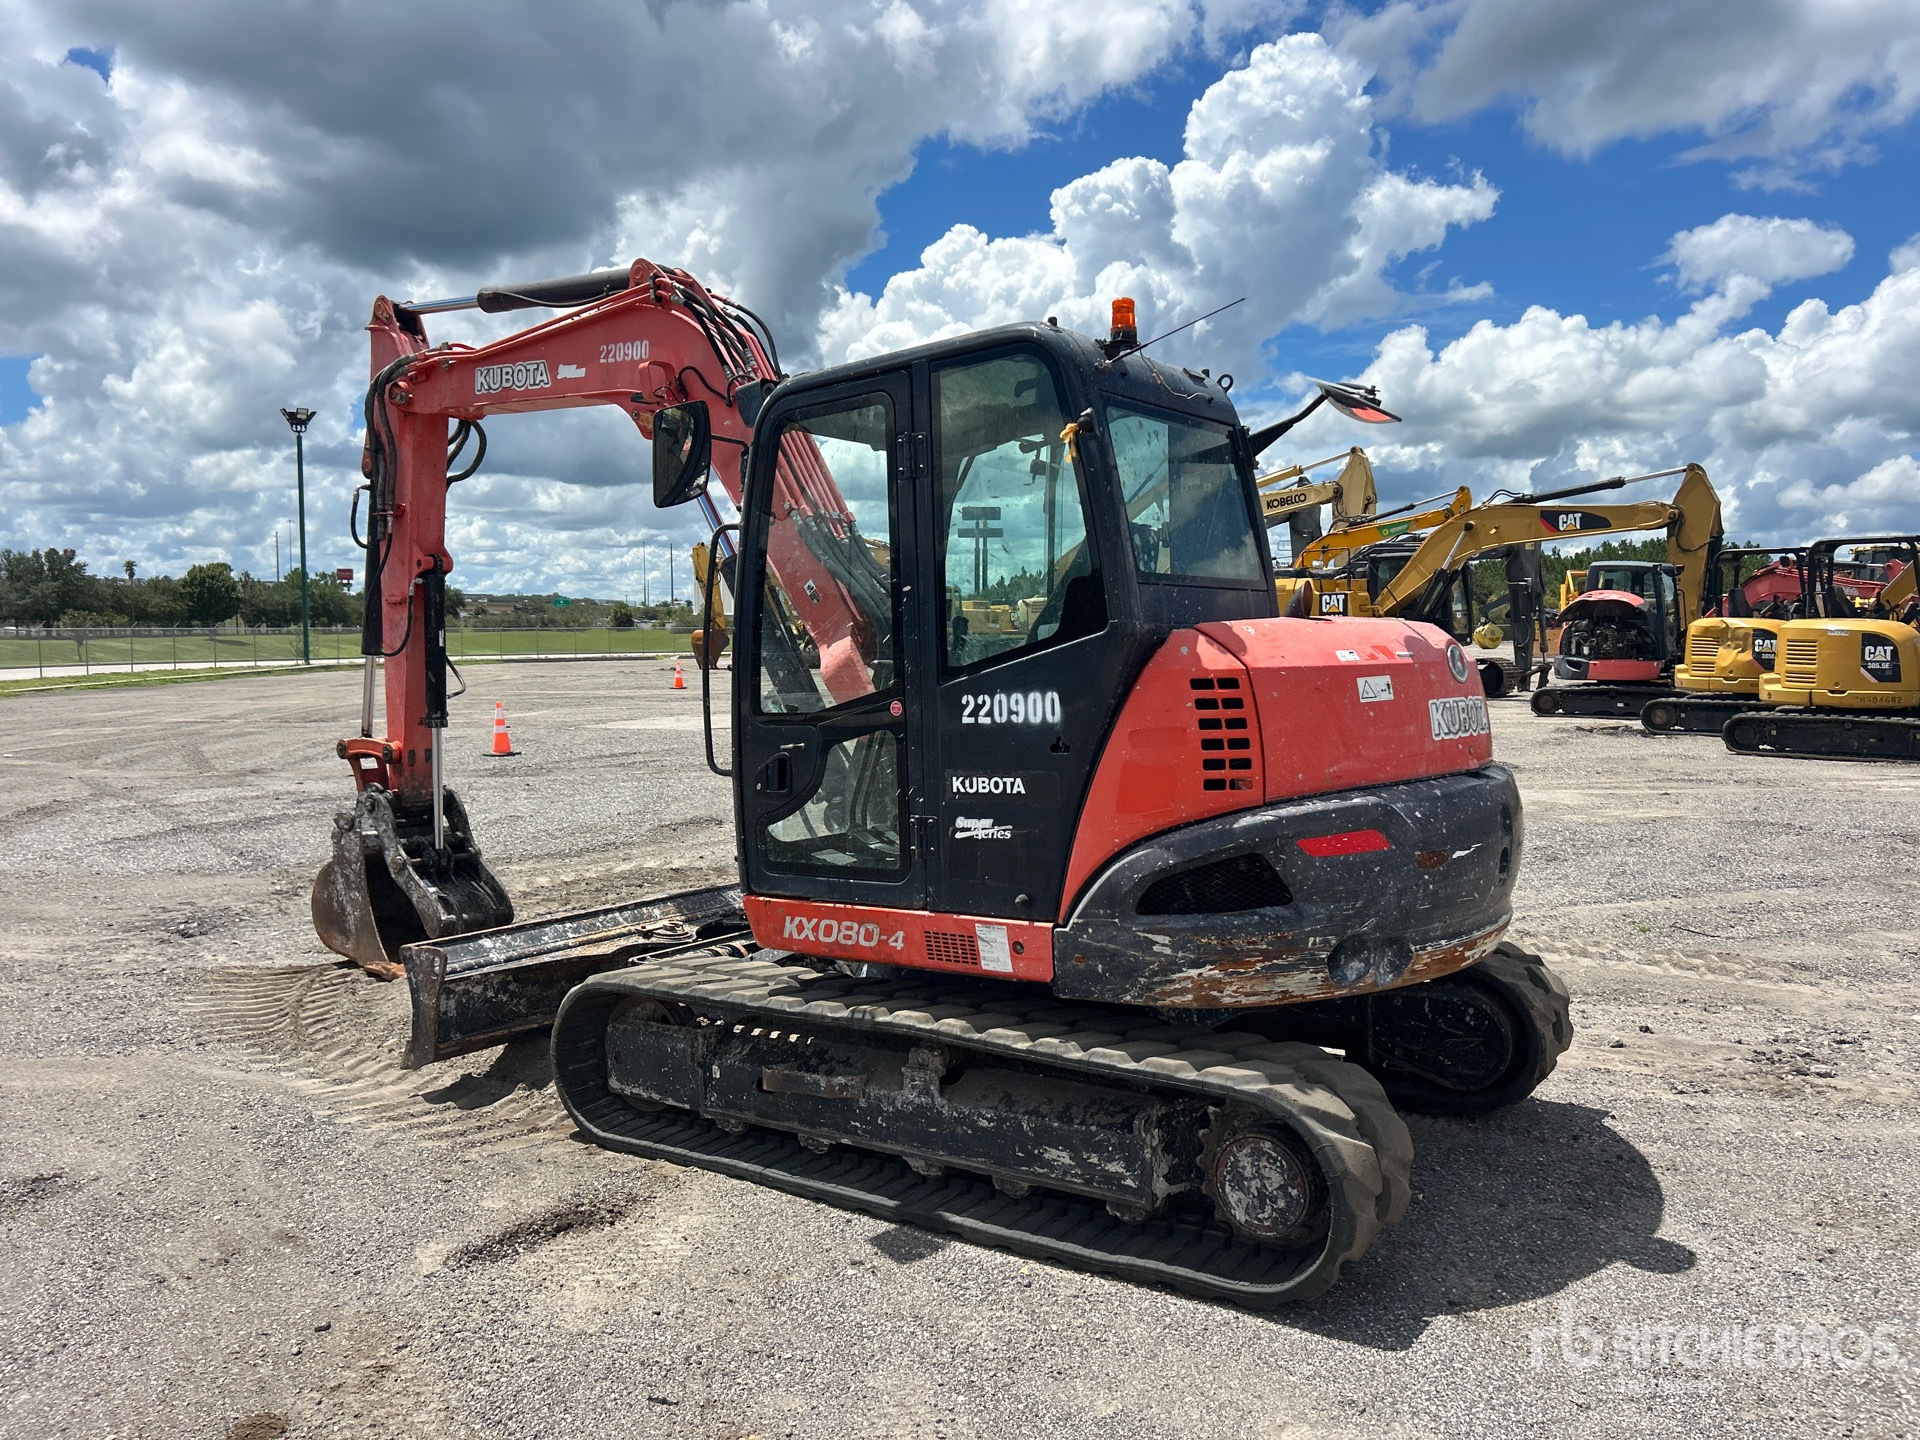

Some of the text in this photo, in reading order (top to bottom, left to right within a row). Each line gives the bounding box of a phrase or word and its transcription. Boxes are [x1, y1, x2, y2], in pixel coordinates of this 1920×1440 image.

[599, 340, 650, 363] 220900
[476, 361, 550, 393] KUBOTA
[1266, 493, 1307, 510] KOBELCO
[1558, 513, 1582, 531] CAT
[1321, 594, 1345, 613] CAT
[1754, 639, 1777, 653] CAT
[1864, 645, 1894, 661] CAT
[961, 691, 1061, 724] 220900
[1430, 697, 1489, 738] KUBOTA
[952, 776, 1026, 794] KUBOTA
[783, 915, 905, 951] KX080-4
